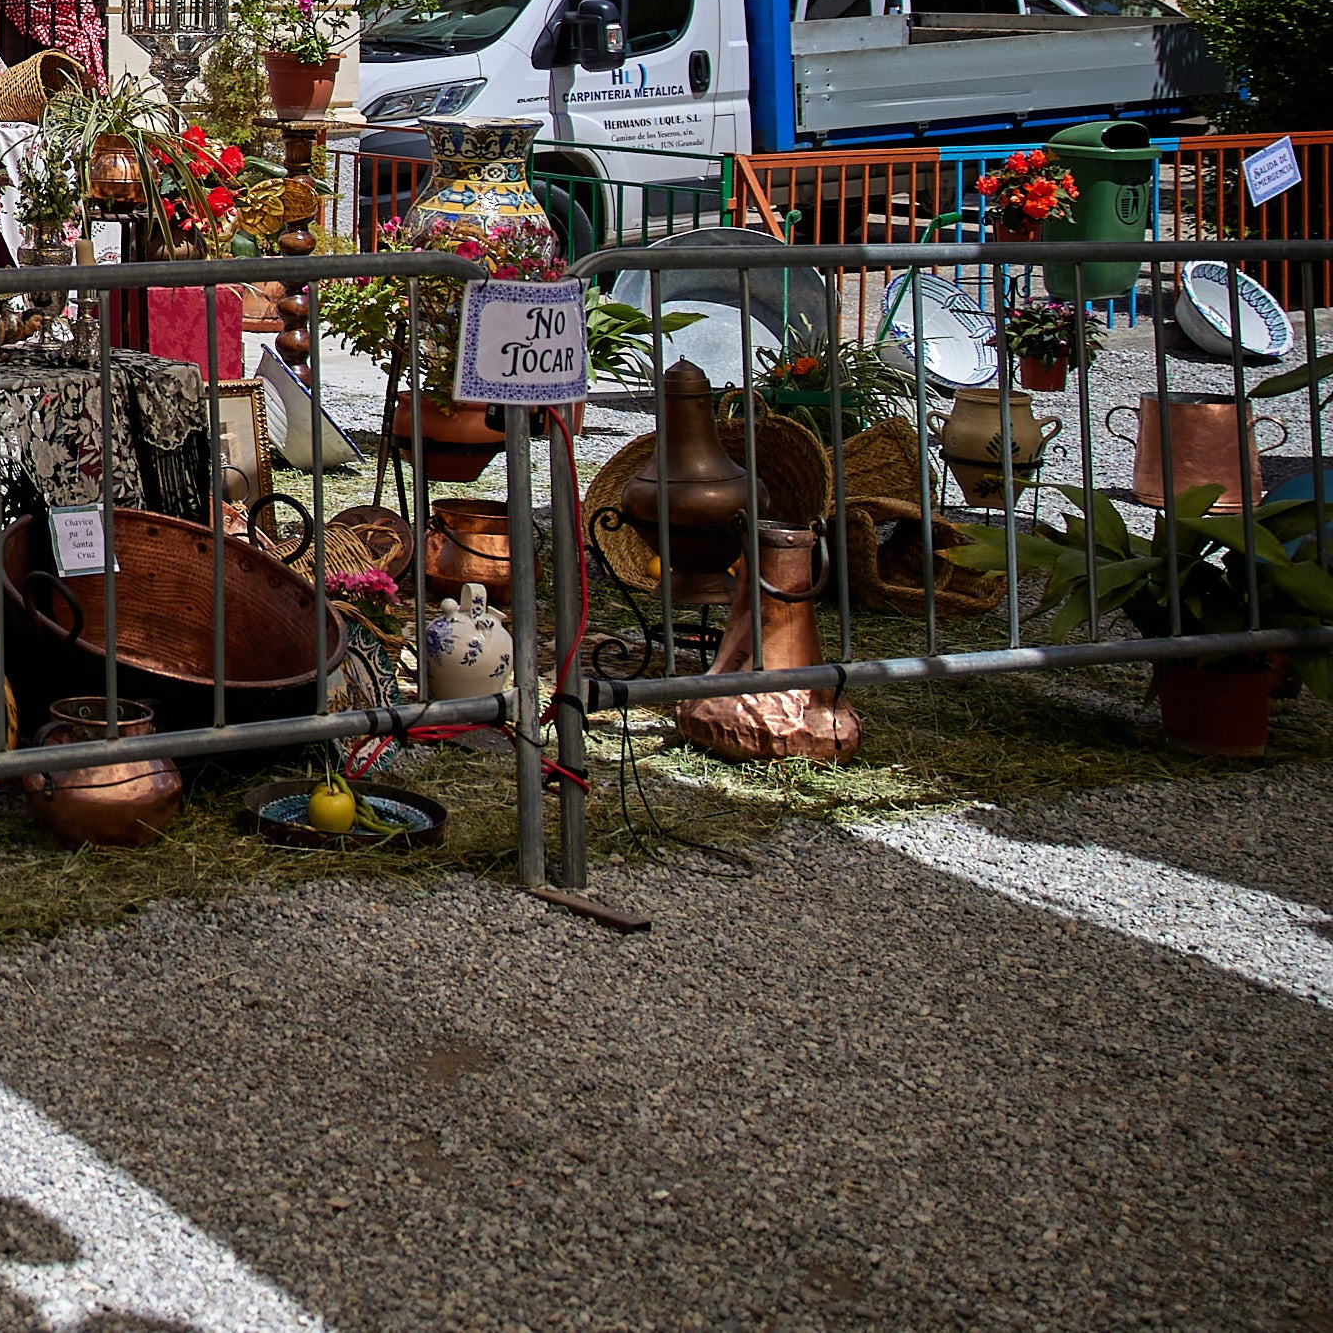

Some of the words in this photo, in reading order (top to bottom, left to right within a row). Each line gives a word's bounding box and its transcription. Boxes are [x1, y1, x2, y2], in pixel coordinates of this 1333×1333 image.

[562, 88, 632, 103] CARPINTERIA
[634, 84, 685, 98] METÁLICA
[604, 118, 652, 130] HERMANOS
[686, 114, 702, 123] S.L.
[611, 133, 636, 142] Camino
[637, 131, 646, 140] de
[646, 130, 656, 139] los
[660, 141, 674, 149] JUN
[675, 138, 705, 148] (Granada)
[1253, 160, 1279, 180] SALIDA
[1279, 154, 1289, 164] DE
[1254, 163, 1294, 190] EMERGENCIA
[501, 341, 575, 378] TOCAR
[64, 518, 94, 527] Chavico
[69, 531, 78, 540] pa
[85, 527, 93, 536] la
[72, 540, 94, 549] Santa
[77, 551, 96, 560] Cruz
